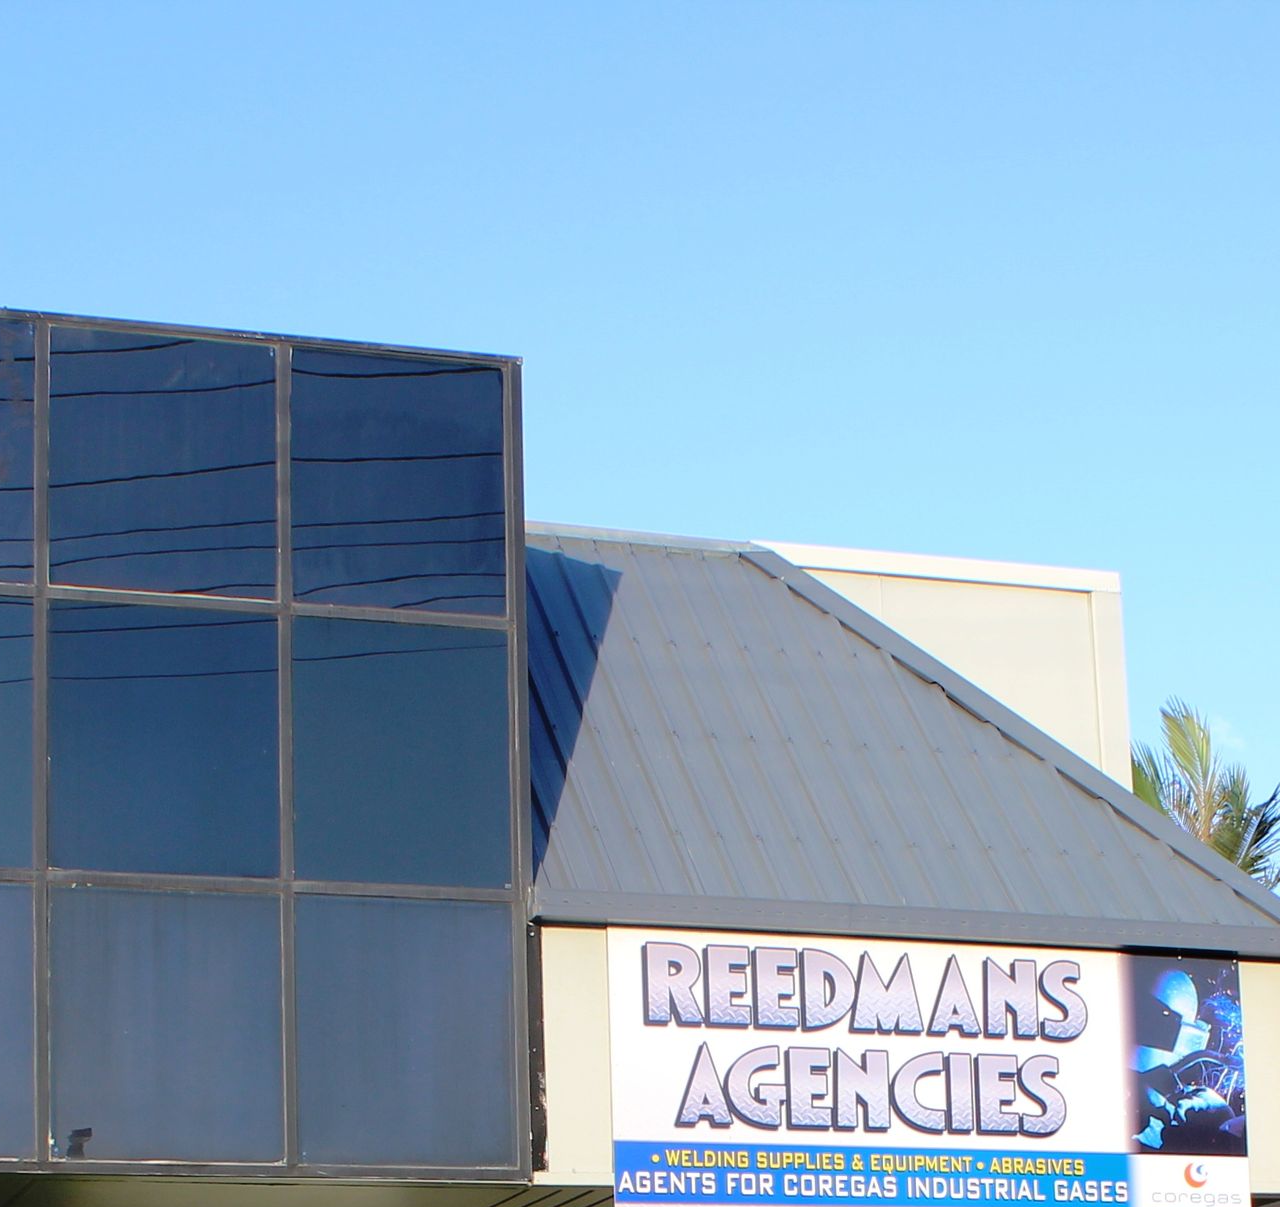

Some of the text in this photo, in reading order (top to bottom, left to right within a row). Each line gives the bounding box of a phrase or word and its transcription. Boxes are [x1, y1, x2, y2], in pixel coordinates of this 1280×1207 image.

[640, 941, 1089, 1041] REEDMANS
[675, 1040, 1068, 1137] AGENCIES
[665, 1149, 1086, 1177] WELDING SUPPLIES & EQUIPMENT ABRASIVES
[618, 1171, 1129, 1203] AGENTS FOR COREGAS INDUSTRIAL GASES
[1151, 1191, 1242, 1207] coregas
